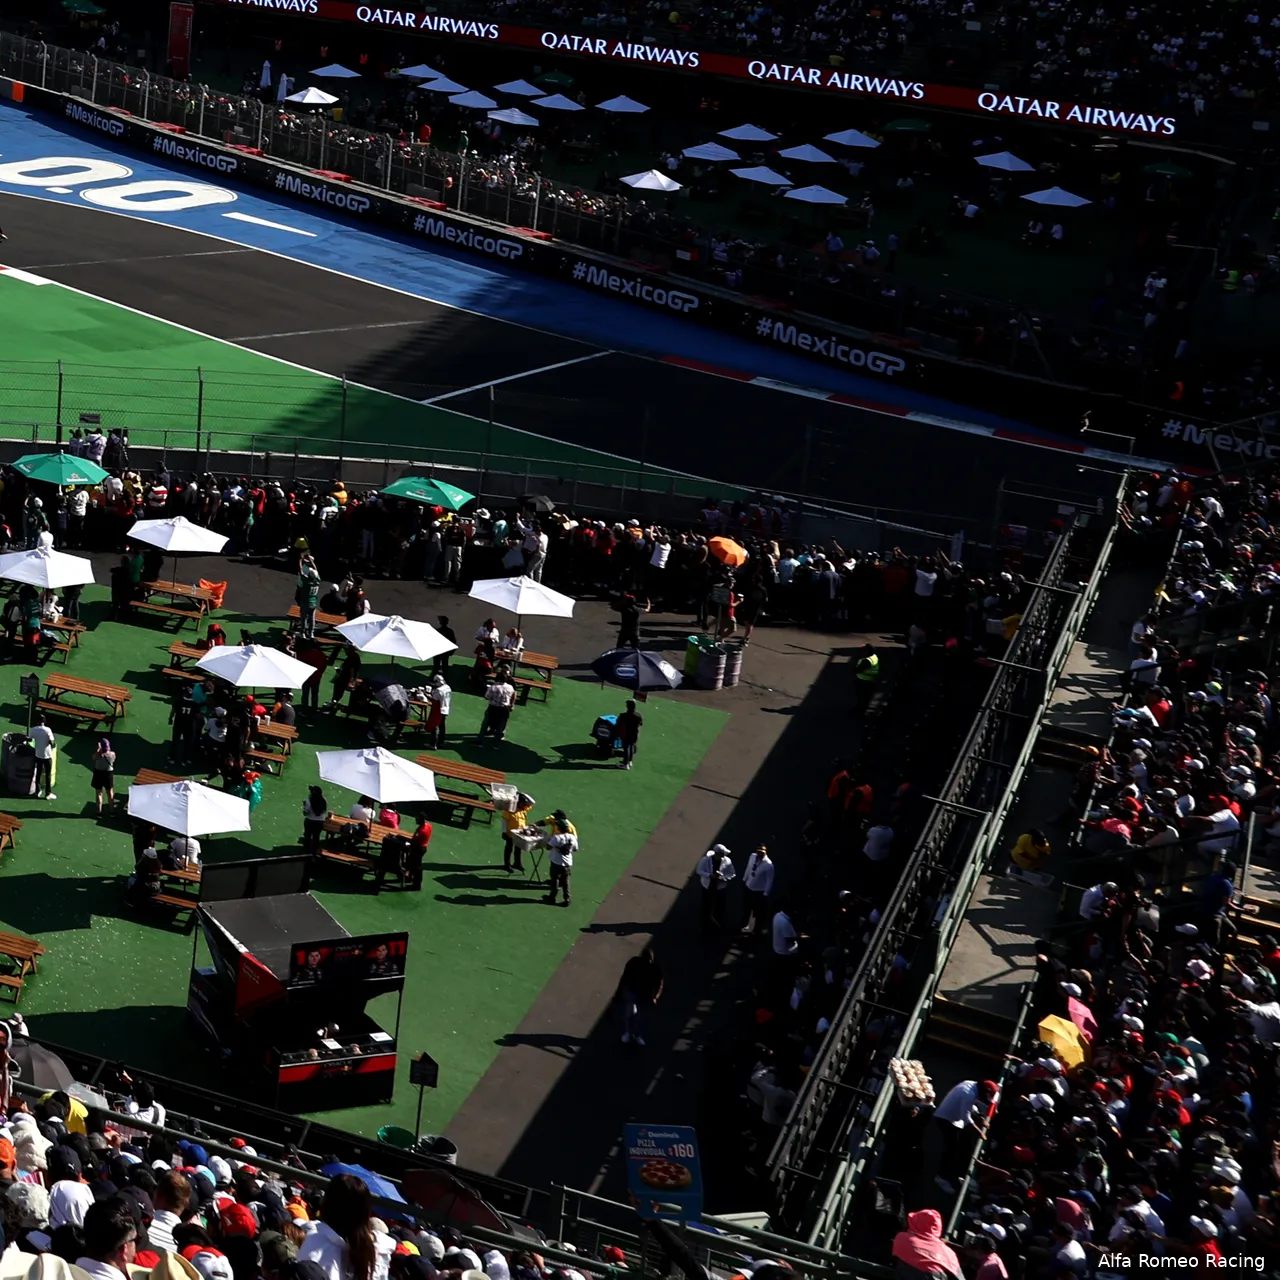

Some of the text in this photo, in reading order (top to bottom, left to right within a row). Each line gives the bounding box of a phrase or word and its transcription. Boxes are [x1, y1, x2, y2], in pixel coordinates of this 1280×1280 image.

[356, 6, 500, 40] QATAR AIRWAYS
[542, 31, 700, 68] QATAR AIRWAYS
[748, 60, 925, 100] QATAR AIRWAYS
[65, 102, 124, 136] #MexicoGP
[977, 91, 1176, 136] QATAR AIRWAYS
[153, 135, 238, 174] #MexicoGP
[275, 172, 370, 214] #MexicoGP
[414, 214, 524, 260] #MexicoGP
[572, 261, 700, 314] #MexicoGP
[756, 316, 906, 377] #MexicoGP
[668, 1142, 694, 1158] $160
